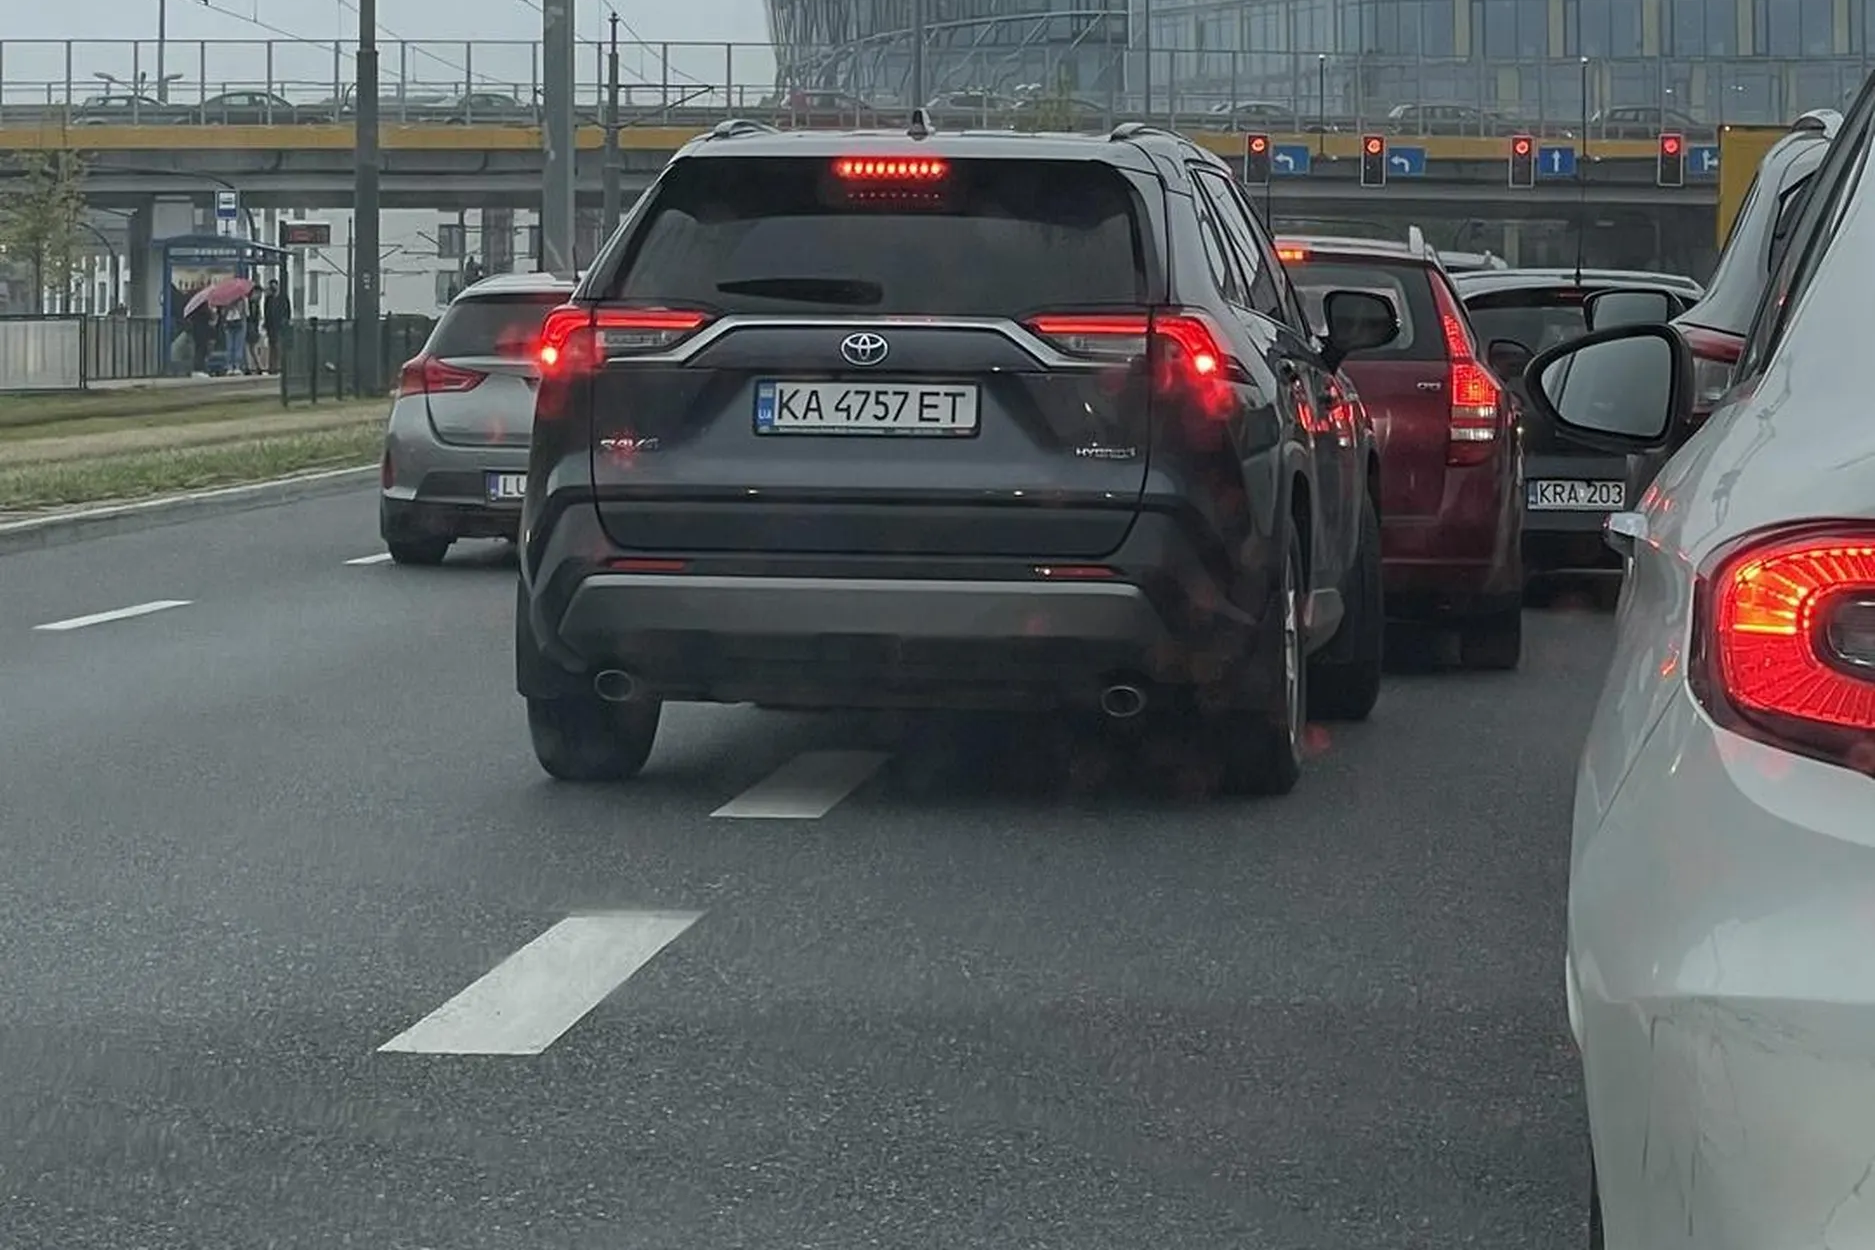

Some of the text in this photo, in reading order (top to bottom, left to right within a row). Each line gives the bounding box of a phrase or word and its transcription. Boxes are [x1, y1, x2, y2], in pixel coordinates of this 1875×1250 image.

[777, 389, 967, 423] KA 4757 ET
[1539, 483, 1623, 504] KRA 203
